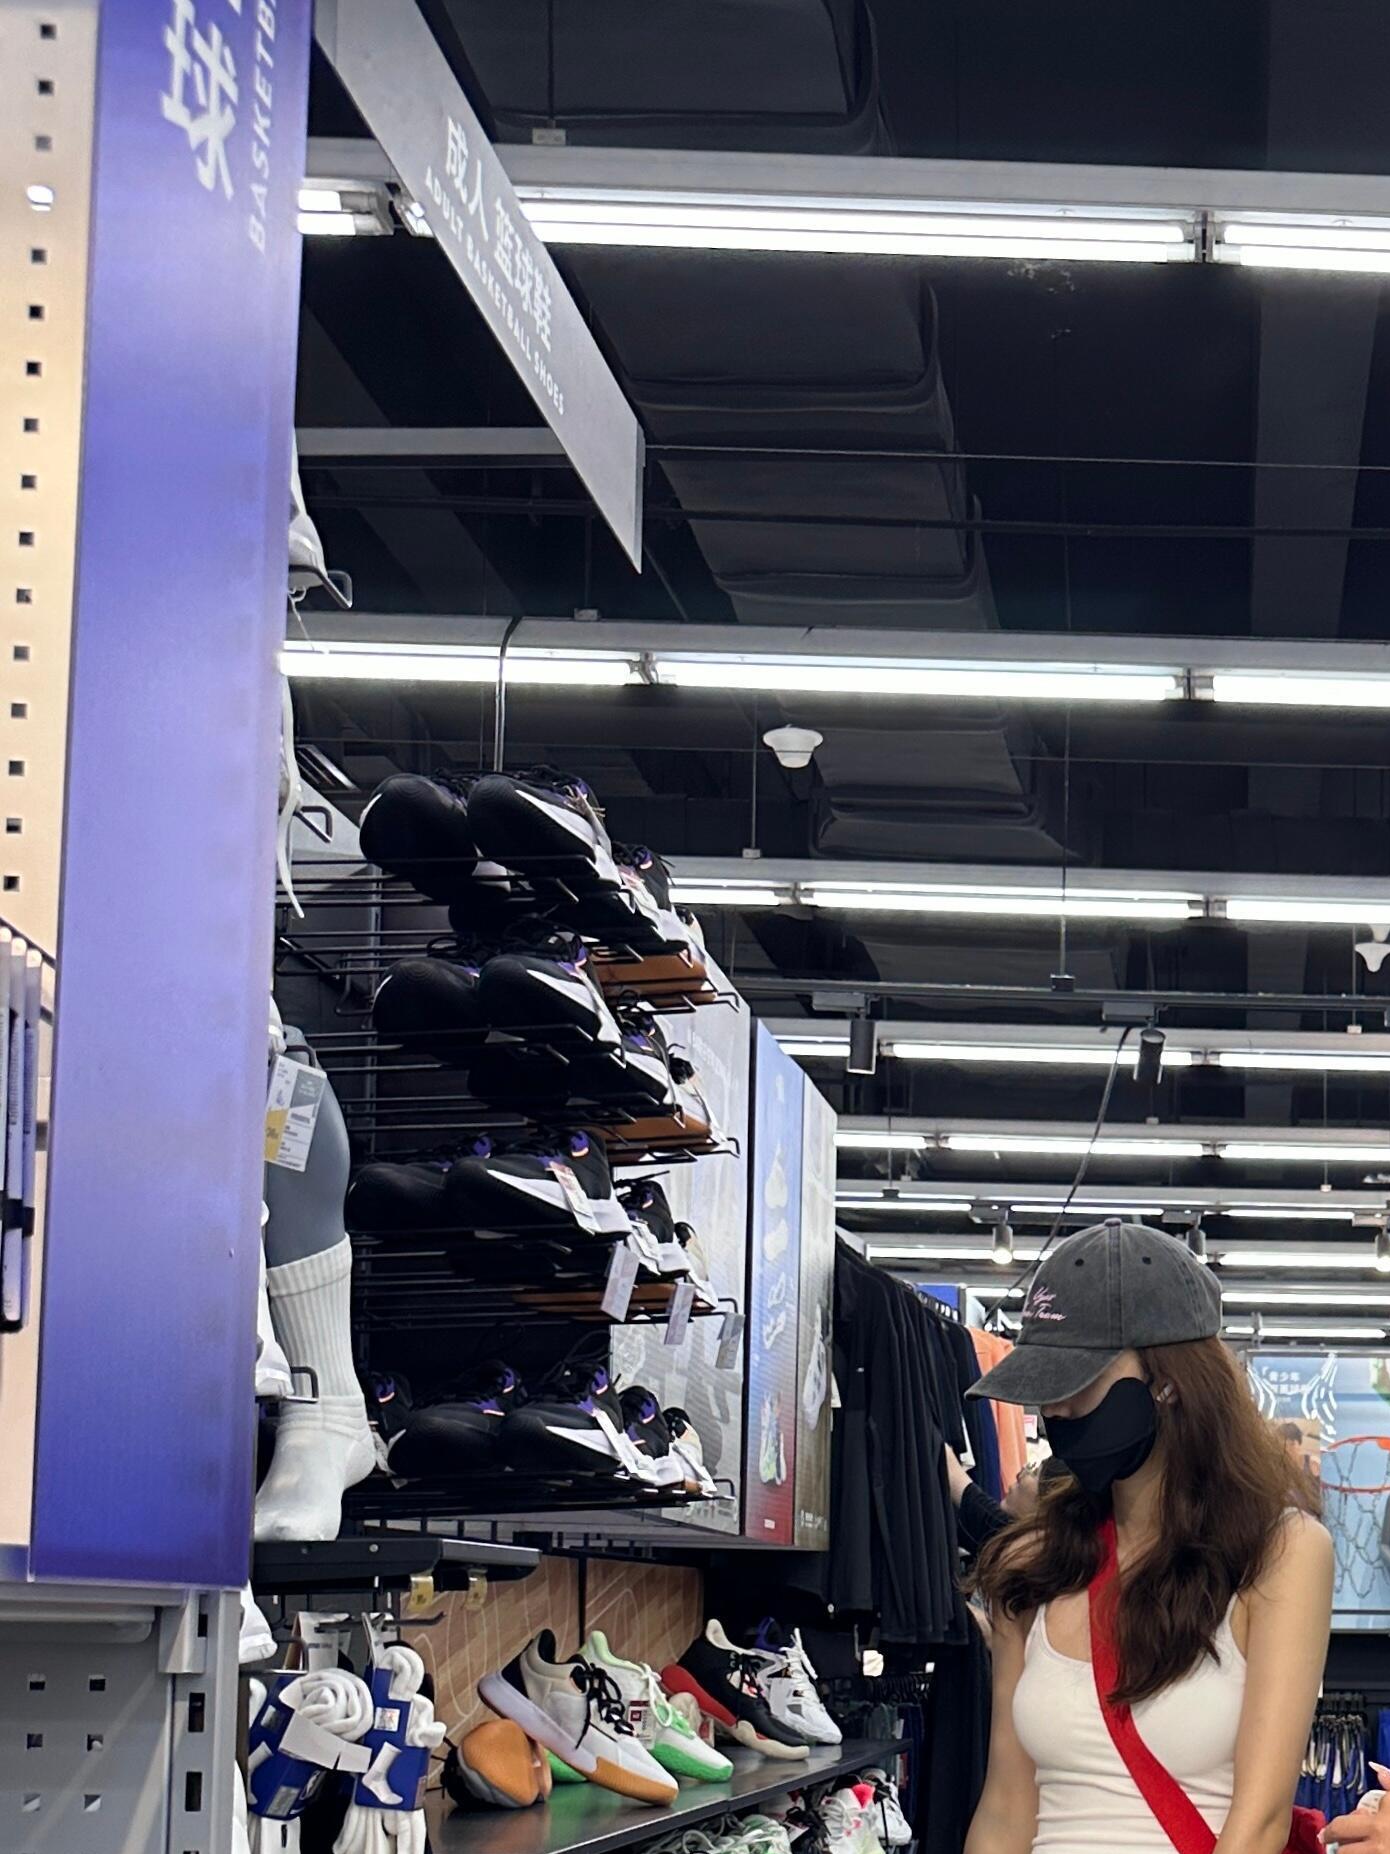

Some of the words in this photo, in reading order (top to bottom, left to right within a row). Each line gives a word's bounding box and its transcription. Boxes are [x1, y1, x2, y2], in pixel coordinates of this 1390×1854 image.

[161, 0, 241, 200] 球
[250, 0, 276, 254] BASKETB
[425, 165, 463, 243] ADULT
[466, 233, 532, 361] BASKETBALL
[534, 350, 564, 416] SHOES
[446, 115, 489, 242] 成人
[494, 196, 551, 352] 篮球鞋
